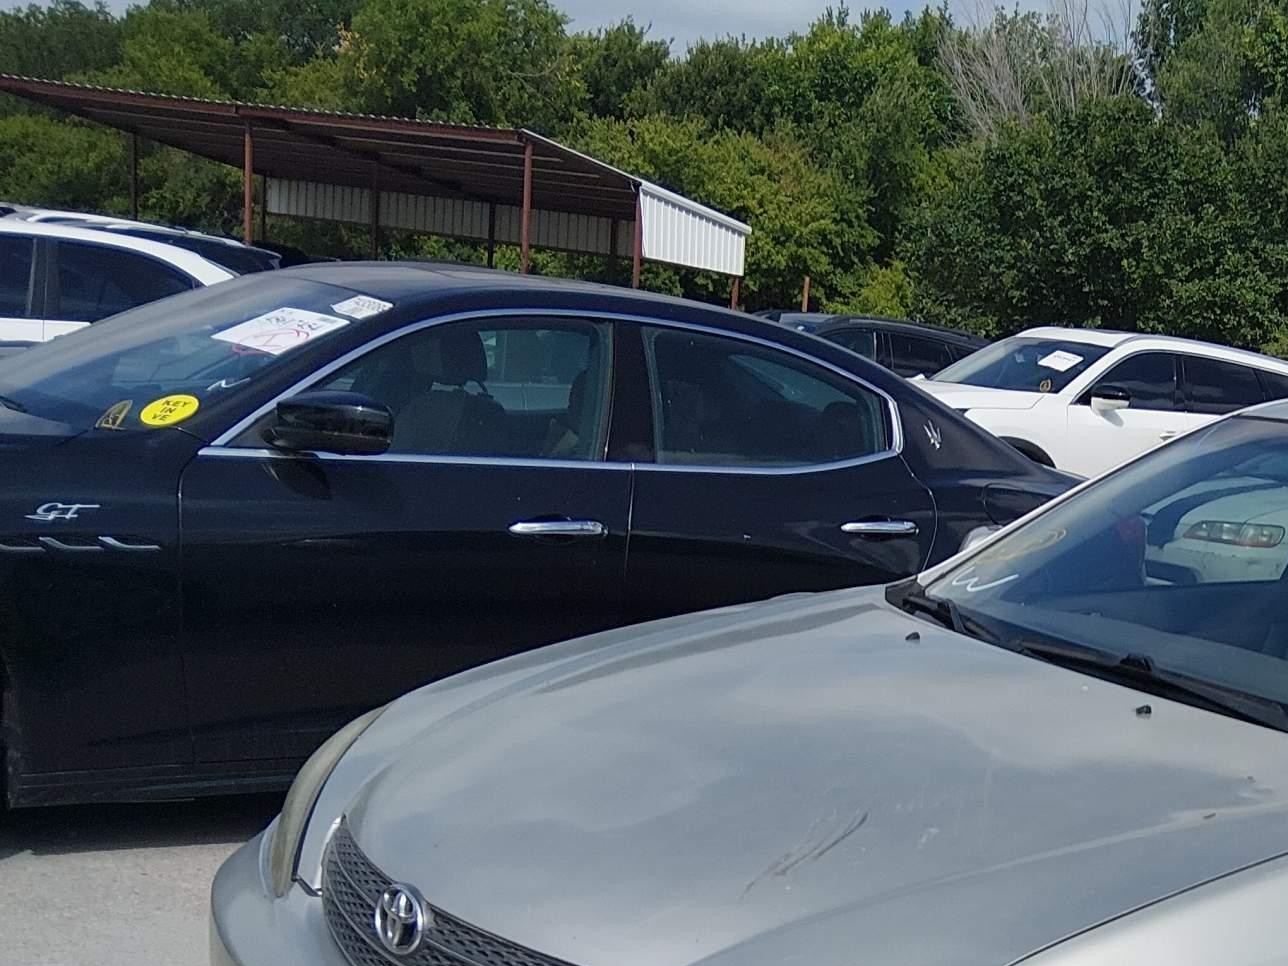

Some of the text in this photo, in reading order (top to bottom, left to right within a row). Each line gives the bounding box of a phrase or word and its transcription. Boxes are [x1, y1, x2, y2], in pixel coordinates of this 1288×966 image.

[161, 399, 192, 408] KEY
[159, 406, 177, 414] IN
[23, 502, 101, 521] GT
